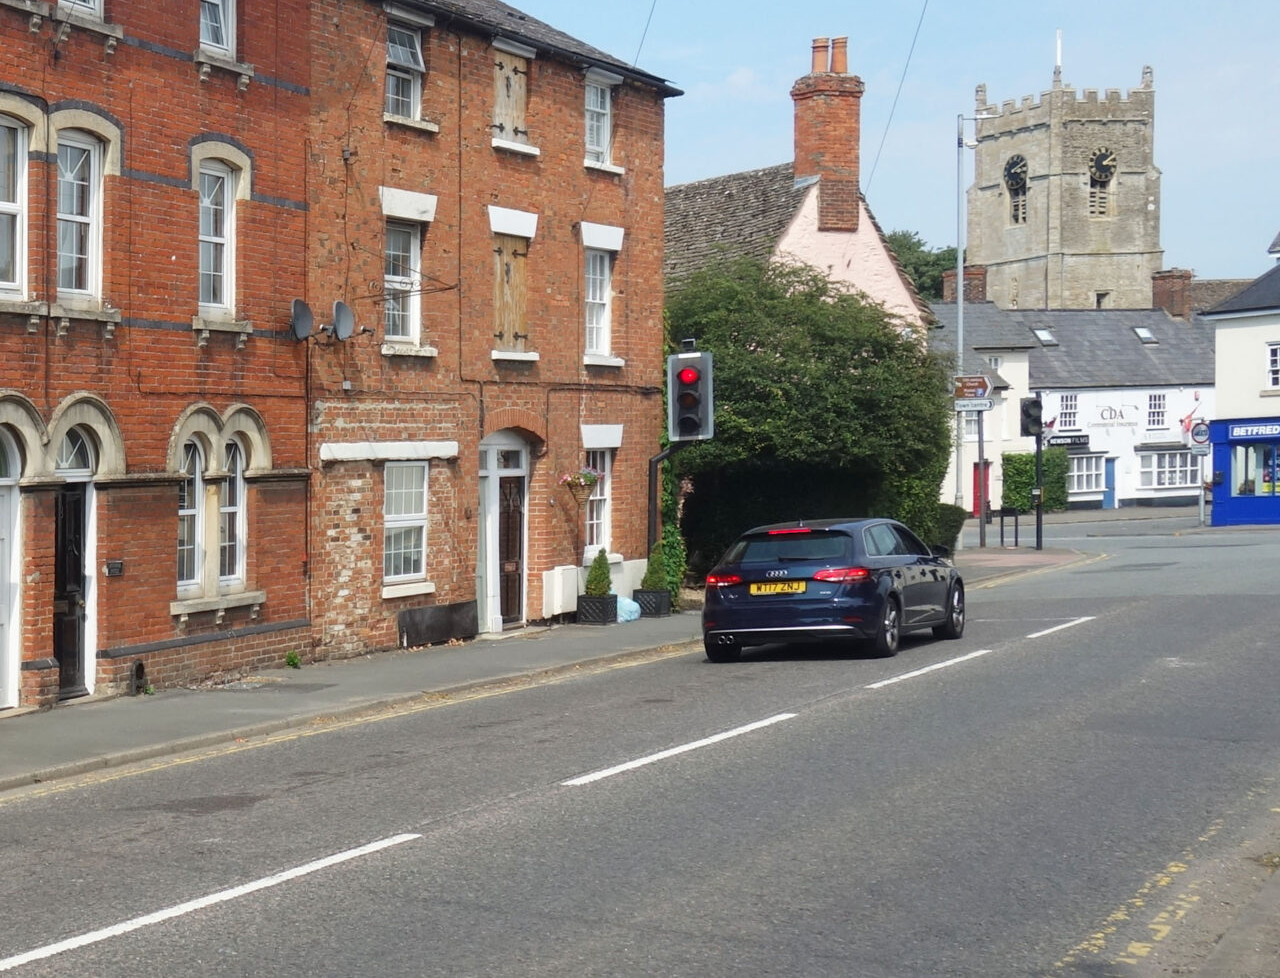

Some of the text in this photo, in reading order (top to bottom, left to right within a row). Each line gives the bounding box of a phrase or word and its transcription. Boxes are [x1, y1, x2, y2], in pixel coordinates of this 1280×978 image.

[1101, 409, 1124, 420] CDA
[1233, 425, 1280, 436] BETFRED
[1072, 436, 1089, 444] FILMS
[781, 582, 800, 591] ZNJ
